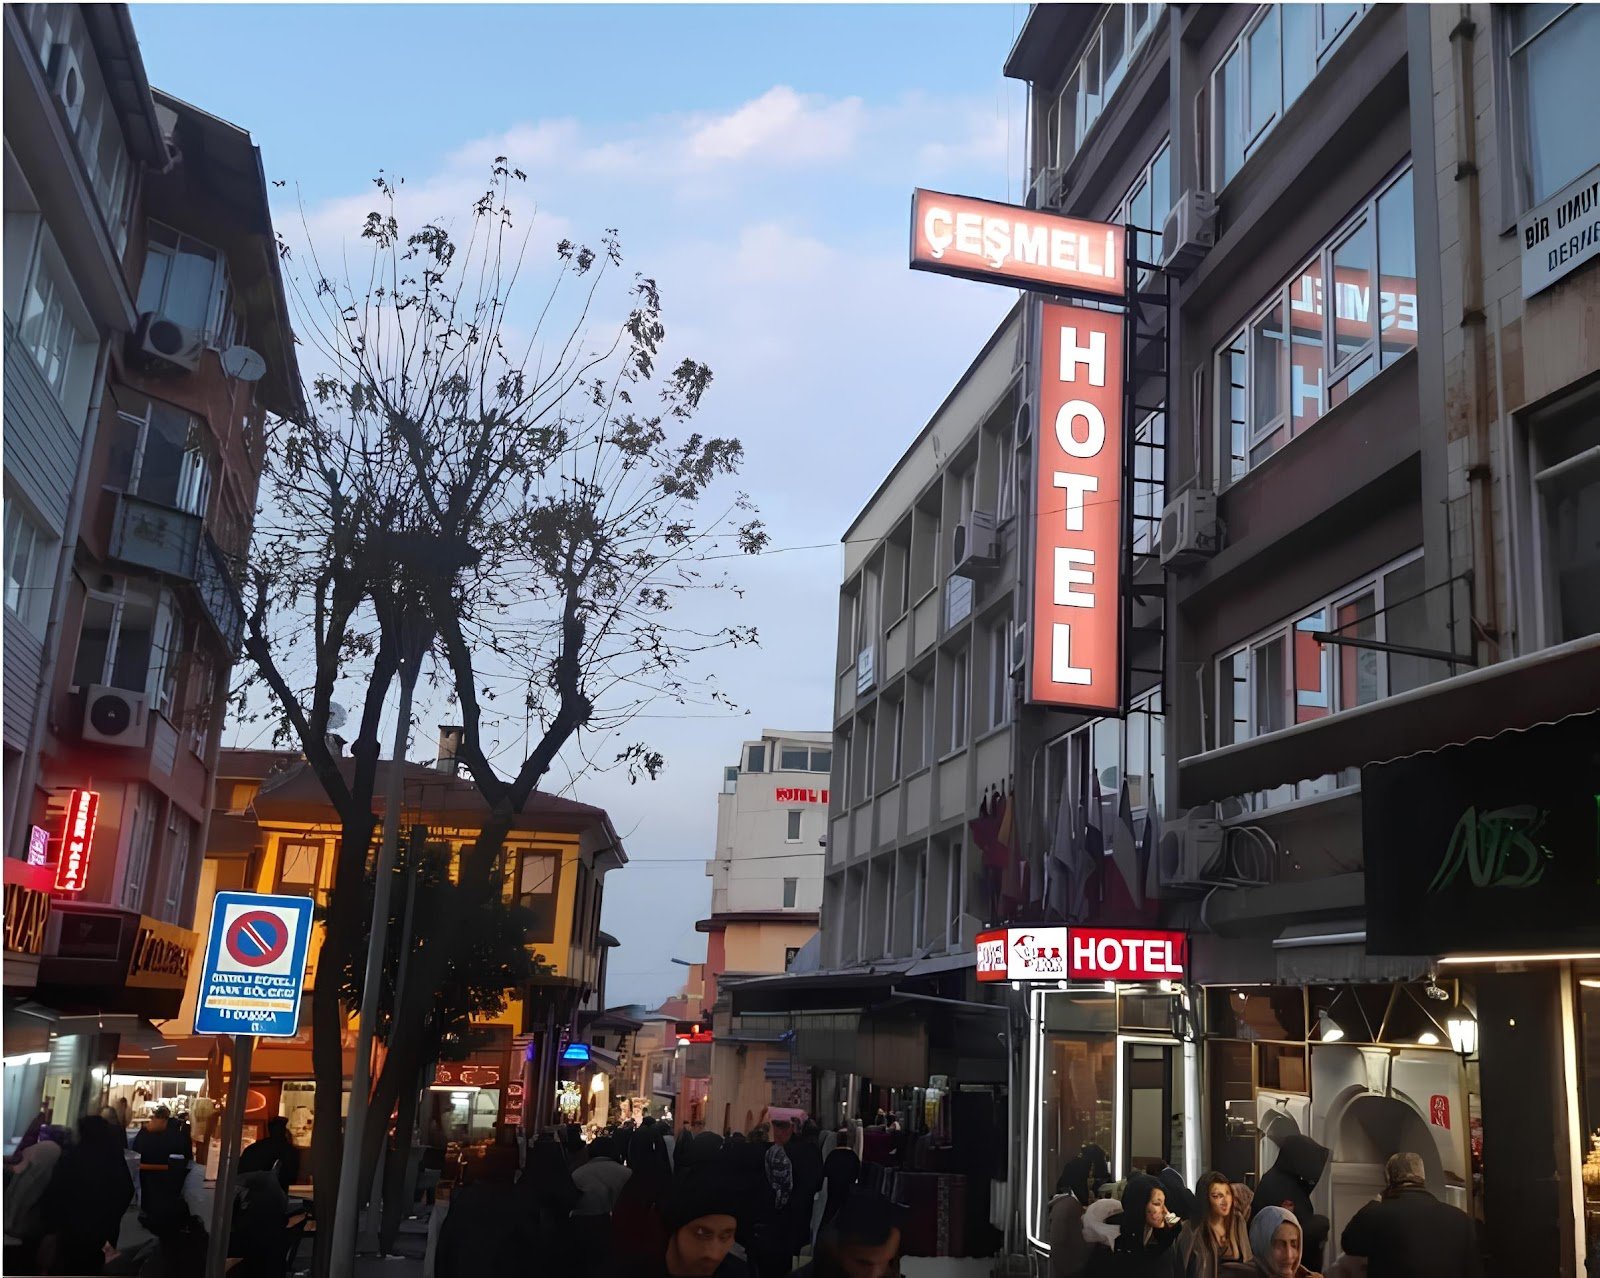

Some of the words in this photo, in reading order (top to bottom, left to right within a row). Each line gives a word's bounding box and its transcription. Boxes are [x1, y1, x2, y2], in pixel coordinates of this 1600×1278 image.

[925, 206, 1116, 279] ÇEŞMELİ
[1525, 217, 1550, 250] BİR
[1556, 182, 1599, 229] UMUT
[1051, 325, 1106, 686] HOTEL
[1074, 937, 1183, 973] HOTEL
